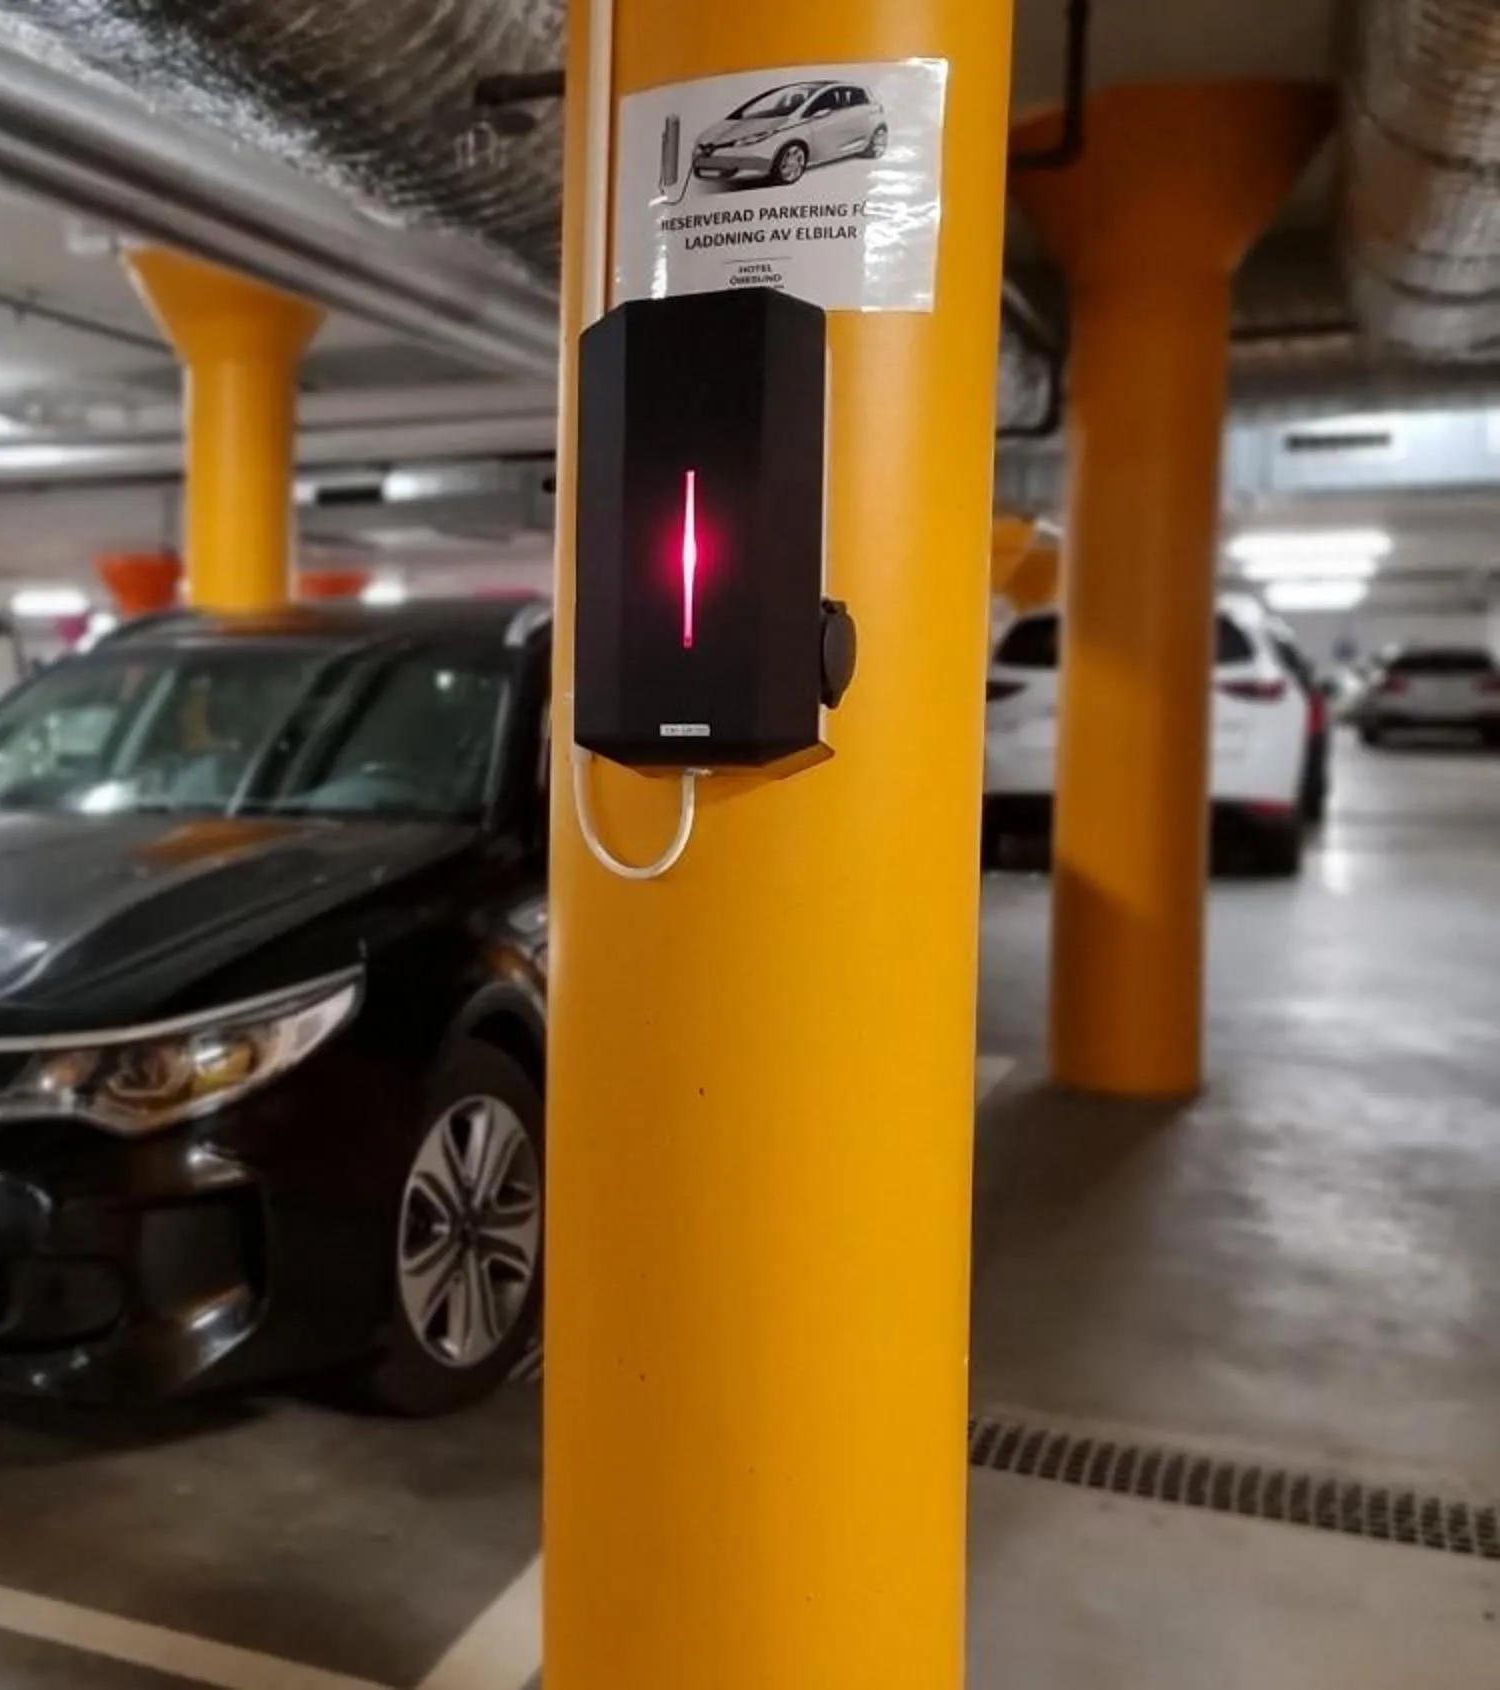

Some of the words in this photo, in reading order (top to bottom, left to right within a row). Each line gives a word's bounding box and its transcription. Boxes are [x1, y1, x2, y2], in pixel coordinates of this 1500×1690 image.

[759, 204, 848, 220] PARKERING
[685, 230, 765, 250] LADDNING
[768, 228, 791, 242] AV
[795, 226, 857, 241] ELBILAR
